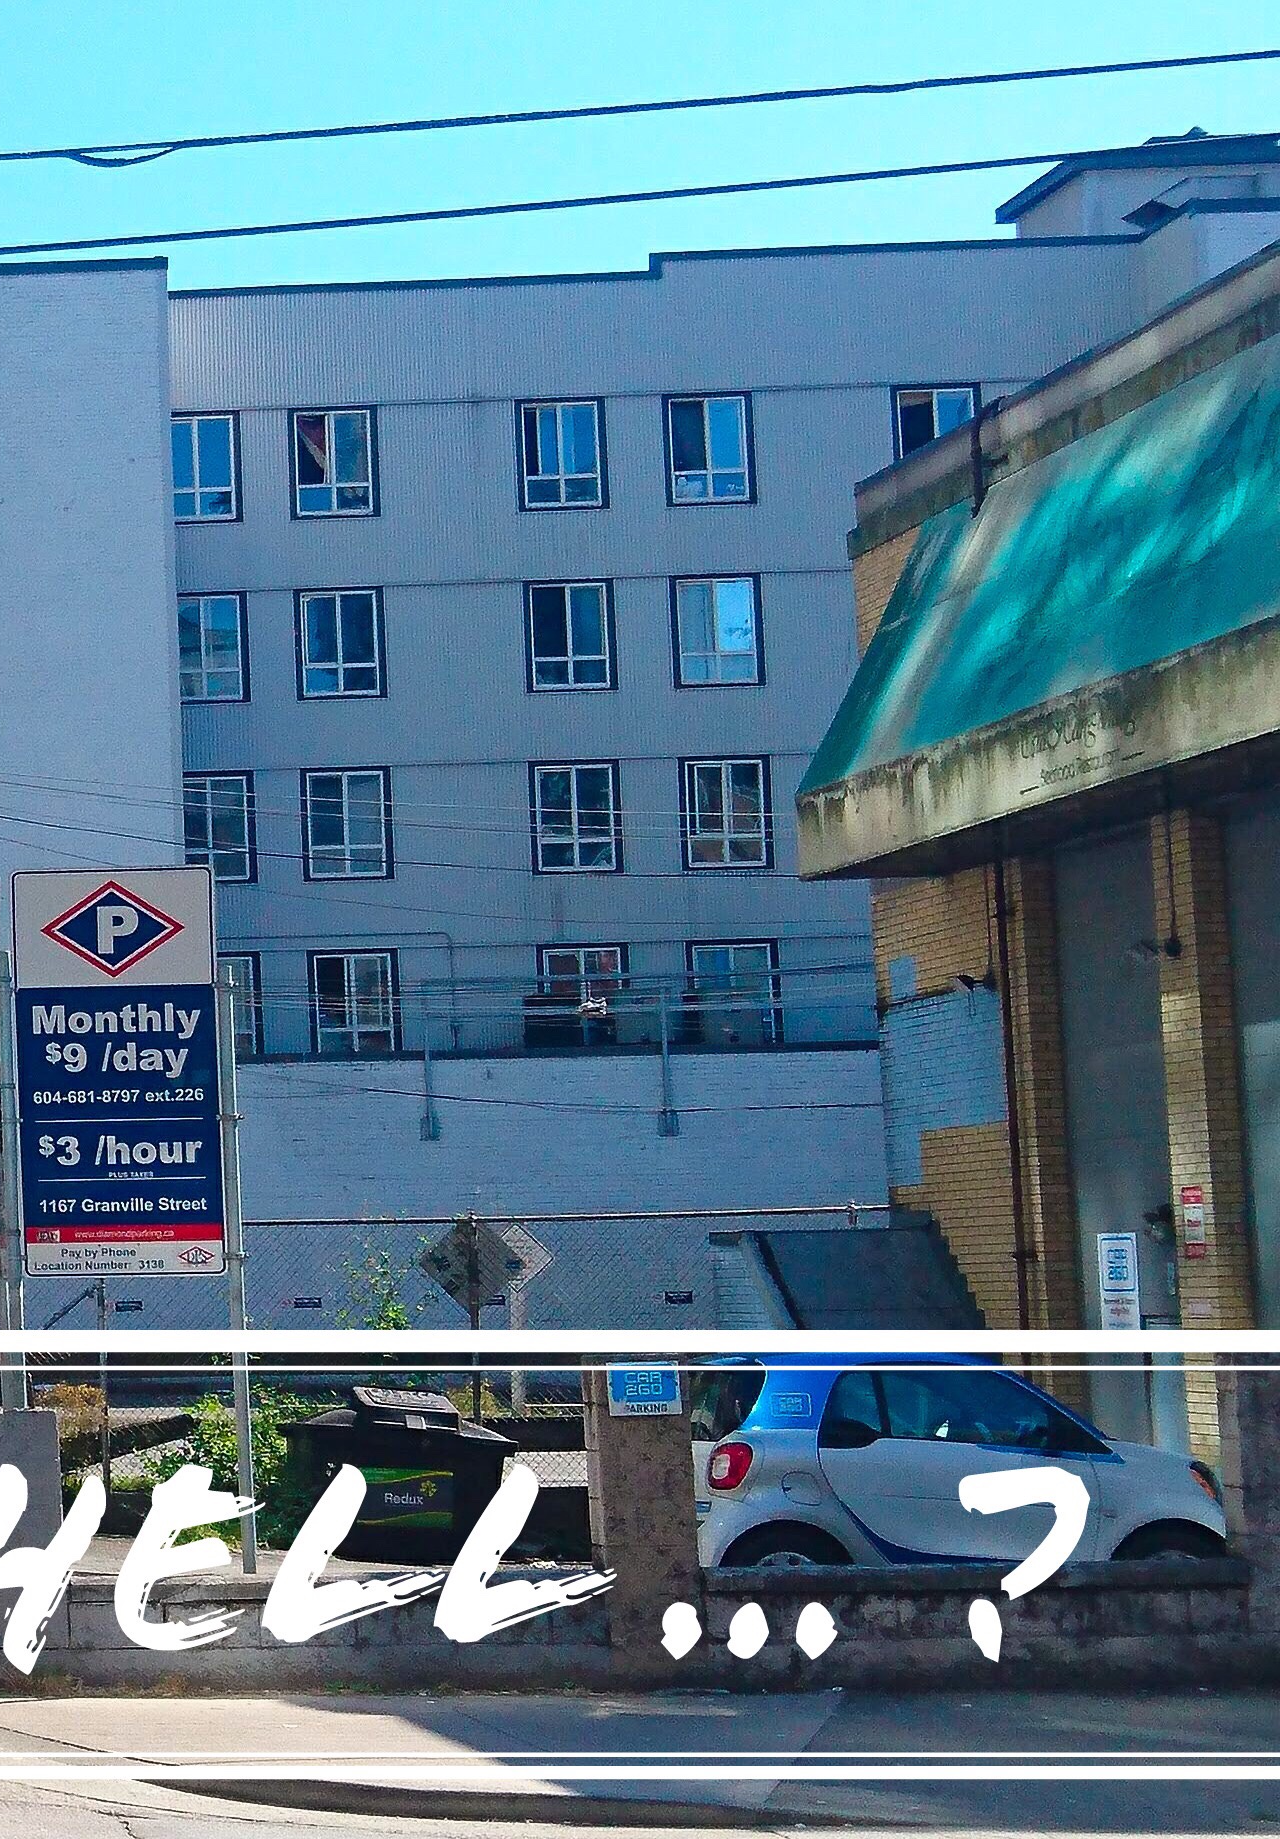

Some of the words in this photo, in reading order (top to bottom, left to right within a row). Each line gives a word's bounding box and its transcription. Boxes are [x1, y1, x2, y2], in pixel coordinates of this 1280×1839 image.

[32, 1002, 201, 1040] Monthly
[45, 1041, 88, 1073] $9
[101, 1041, 189, 1079] /day
[33, 1089, 140, 1105] 604-681-8797
[145, 1087, 205, 1103] ext.226
[38, 1134, 81, 1166] $3
[94, 1134, 203, 1166] /hour
[39, 1199, 77, 1214] 1167
[81, 1197, 154, 1213] Granville
[158, 1196, 208, 1212] Street
[60, 1248, 81, 1260] Pay
[84, 1247, 99, 1260] by
[101, 1246, 137, 1258] Phone
[33, 1261, 82, 1271] Location
[624, 1371, 662, 1383] CAR
[625, 1383, 663, 1396] 2GO
[384, 1492, 424, 1505] Redux
